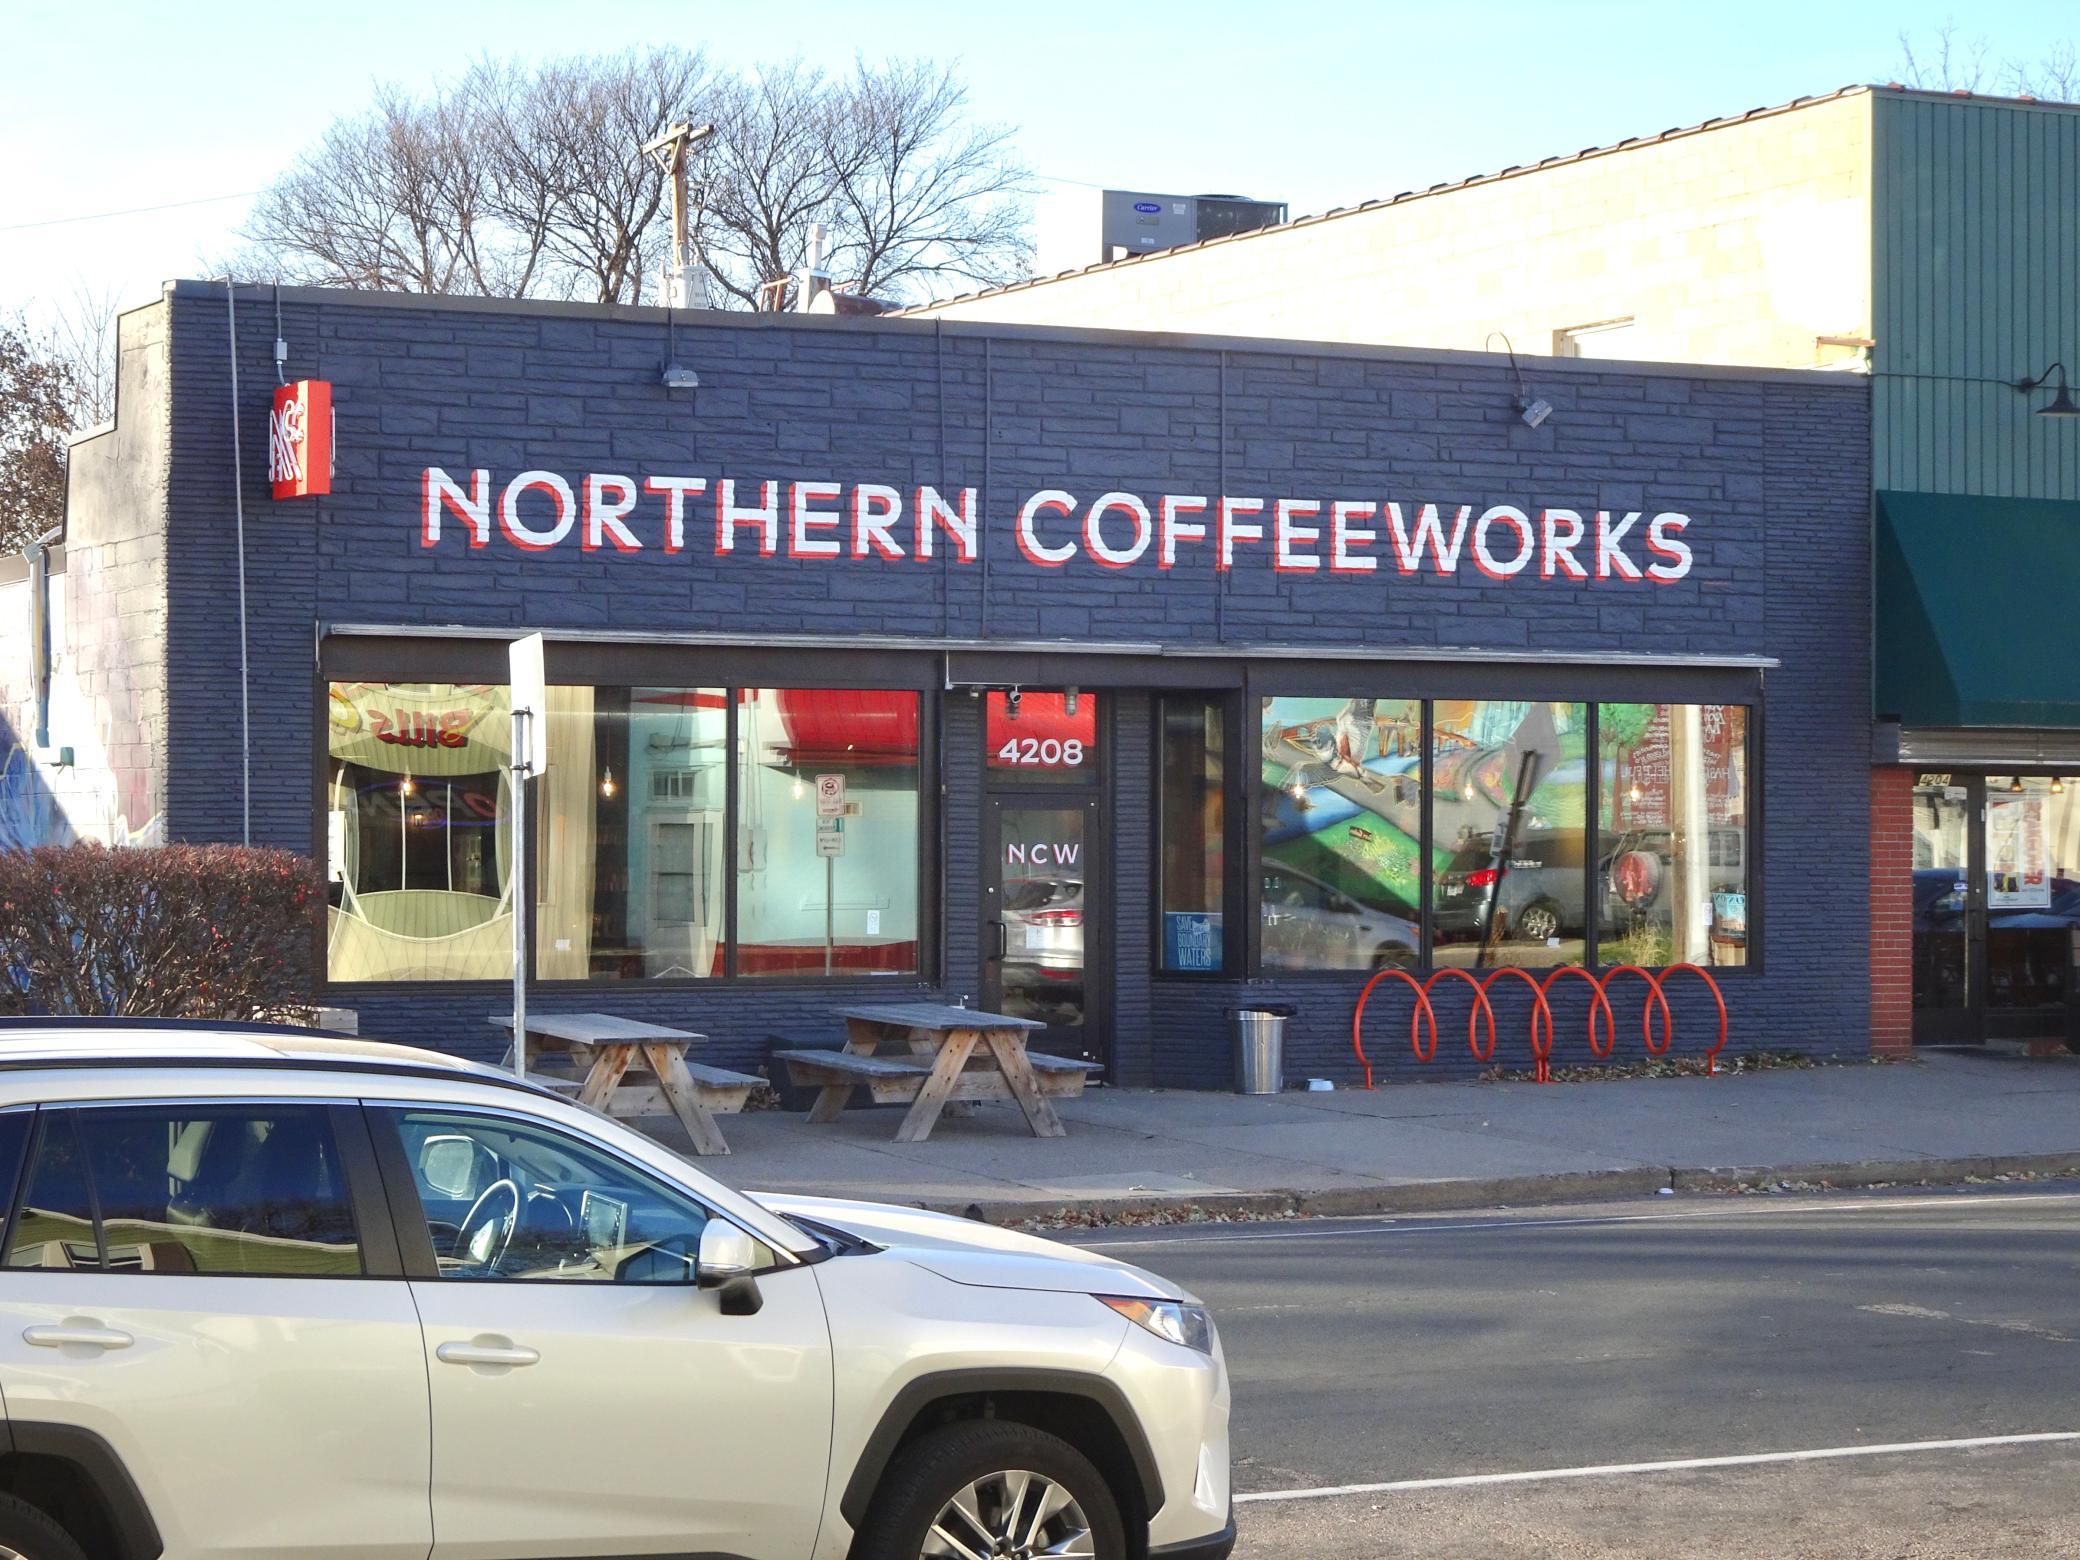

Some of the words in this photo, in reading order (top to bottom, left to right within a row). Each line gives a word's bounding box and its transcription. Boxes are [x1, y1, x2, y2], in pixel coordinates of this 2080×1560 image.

[421, 466, 979, 563] NORTHERN
[1016, 489, 1693, 583] COFFEEWORKS
[999, 738, 1084, 765] 4208
[1920, 774, 1949, 786] 4204
[1007, 843, 1079, 864] NCW
[1176, 916, 1193, 931] SAVE
[1178, 948, 1211, 966] WATERS
